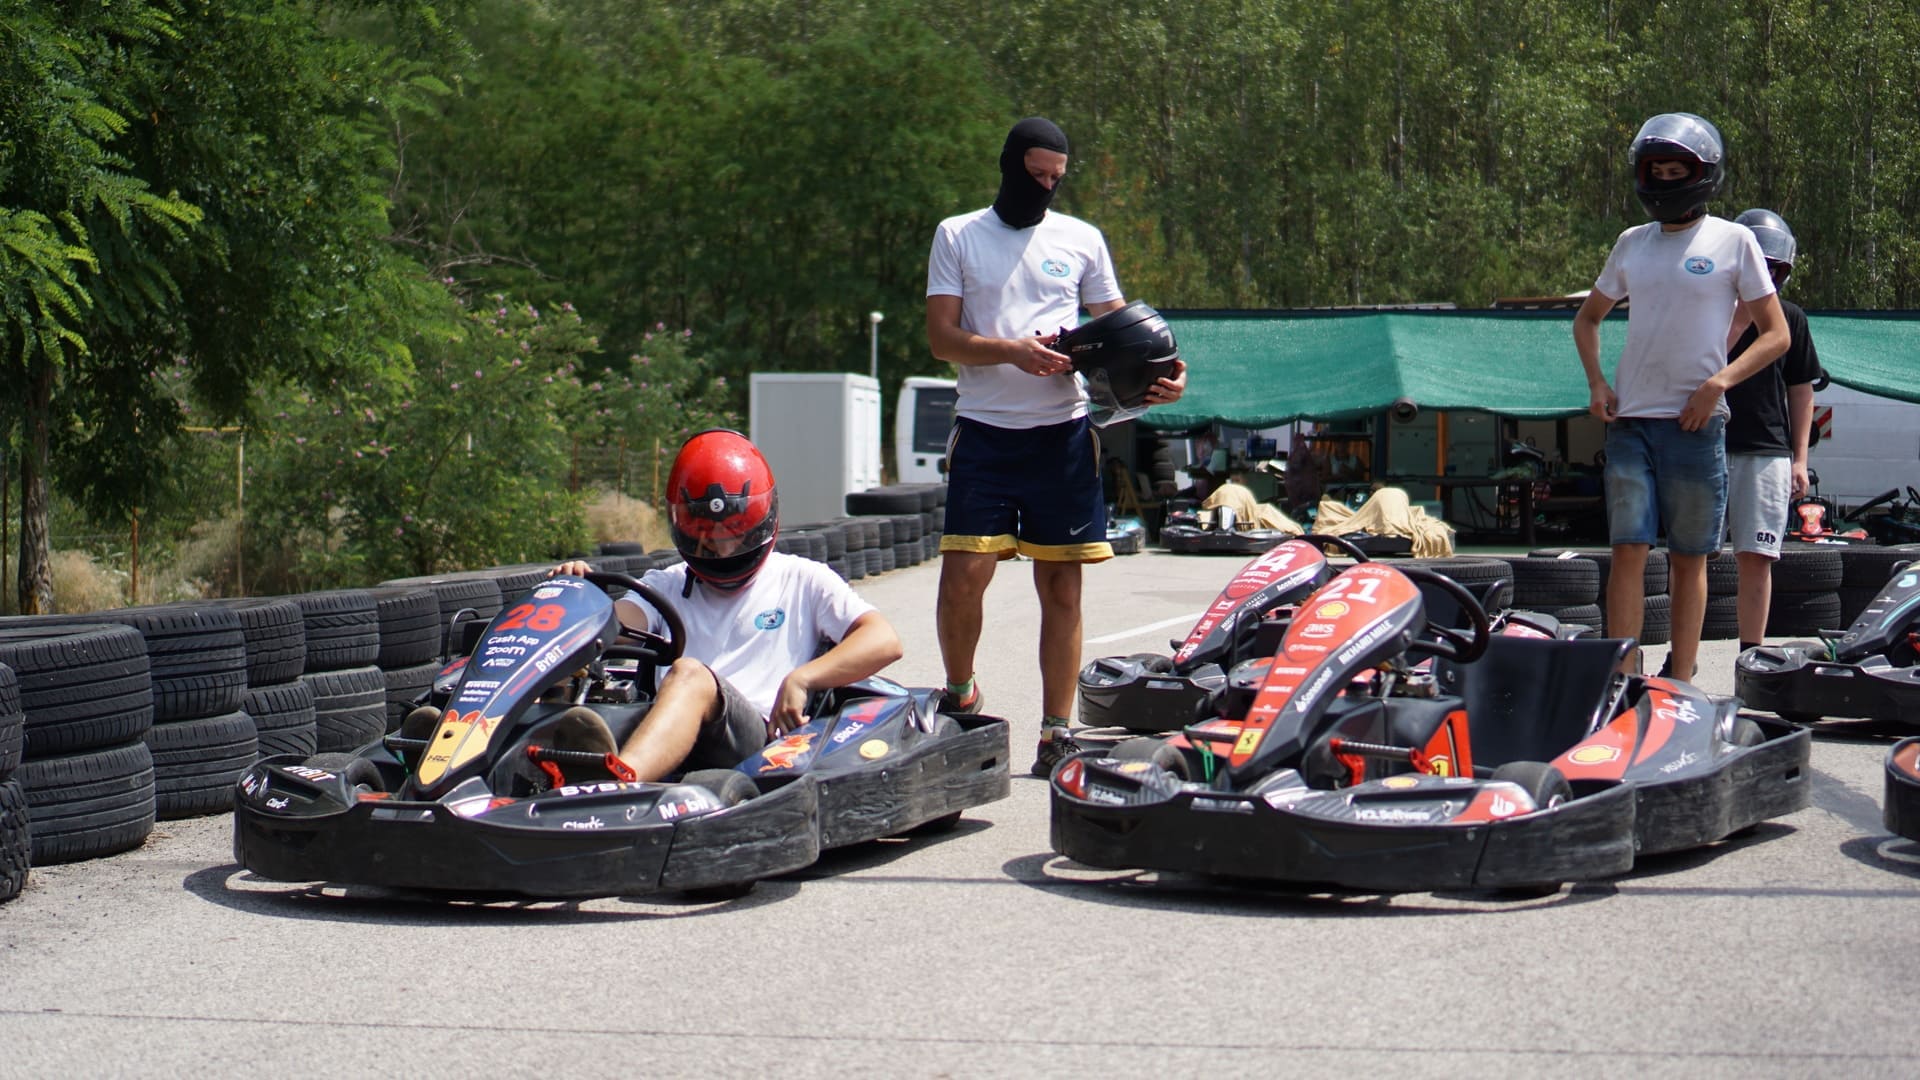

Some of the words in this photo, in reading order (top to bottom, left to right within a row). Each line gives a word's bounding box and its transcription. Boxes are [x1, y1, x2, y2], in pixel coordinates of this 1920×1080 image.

[1757, 532, 1776, 545] GAP
[1315, 578, 1381, 604] 21
[495, 603, 566, 632] 28
[488, 635, 515, 645] Cash
[517, 635, 540, 646] App
[560, 781, 641, 797] BYBIT
[658, 799, 709, 820] Mobil
